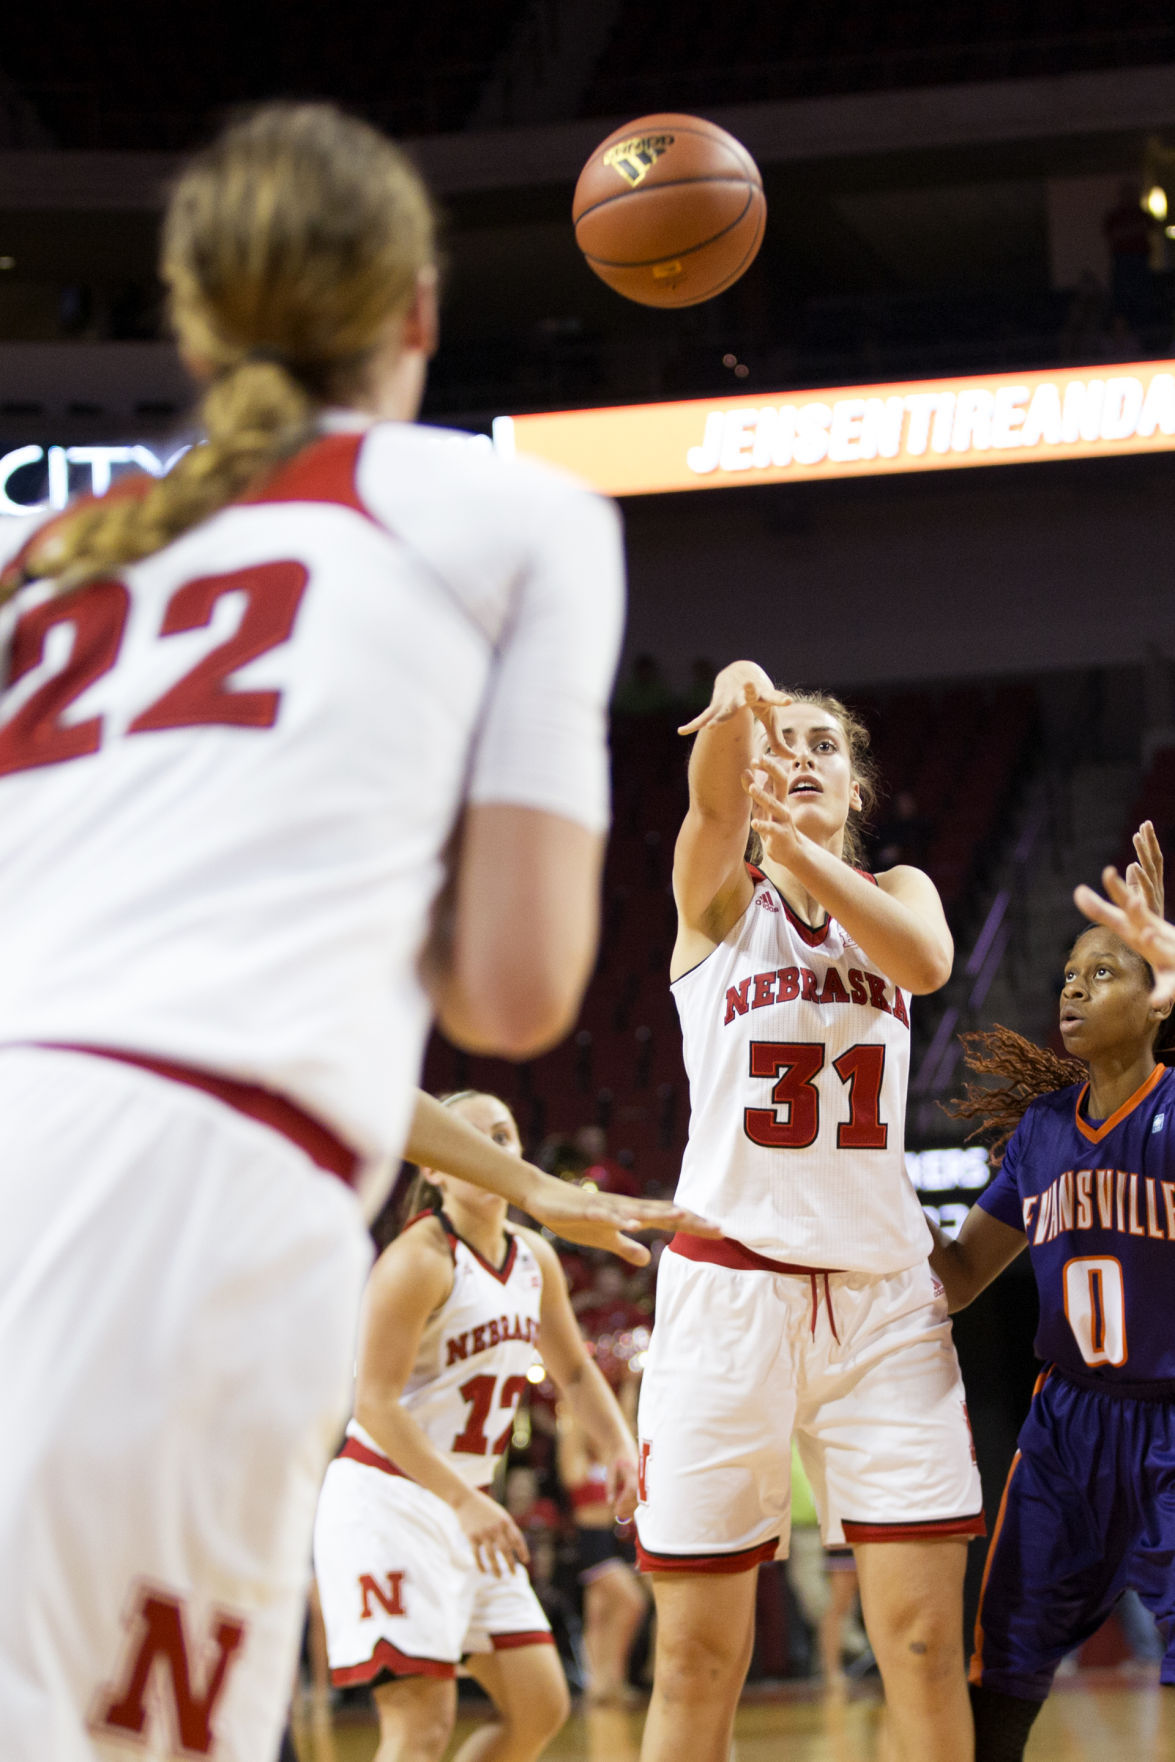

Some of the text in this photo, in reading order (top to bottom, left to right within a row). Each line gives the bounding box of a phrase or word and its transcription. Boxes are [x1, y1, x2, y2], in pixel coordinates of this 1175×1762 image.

[0, 559, 311, 778] 22
[744, 1040, 888, 1150] 31
[1062, 1254, 1129, 1369] 0
[357, 1570, 406, 1619] N
[97, 1590, 246, 1758] N
